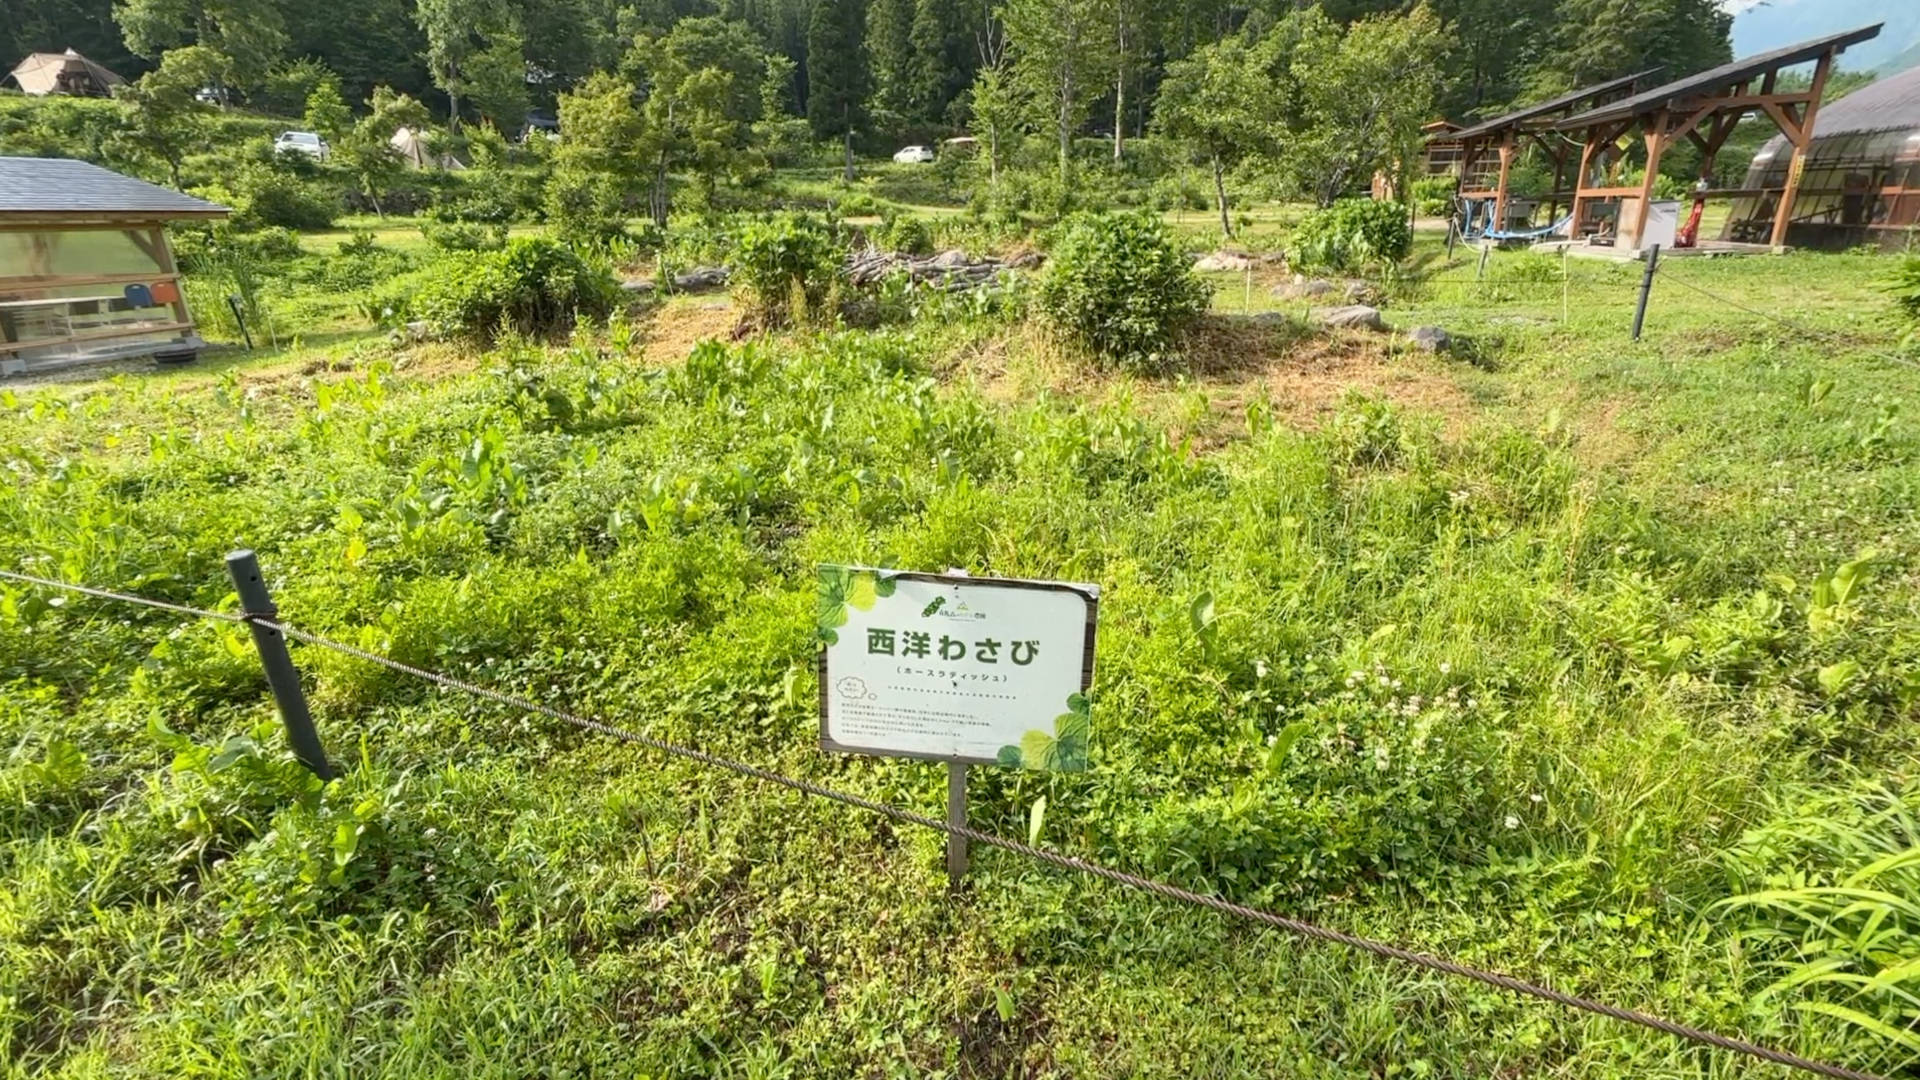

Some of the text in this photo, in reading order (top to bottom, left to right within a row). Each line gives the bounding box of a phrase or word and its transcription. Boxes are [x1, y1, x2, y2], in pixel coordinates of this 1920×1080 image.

[866, 626, 1041, 667] 西洋わさび
